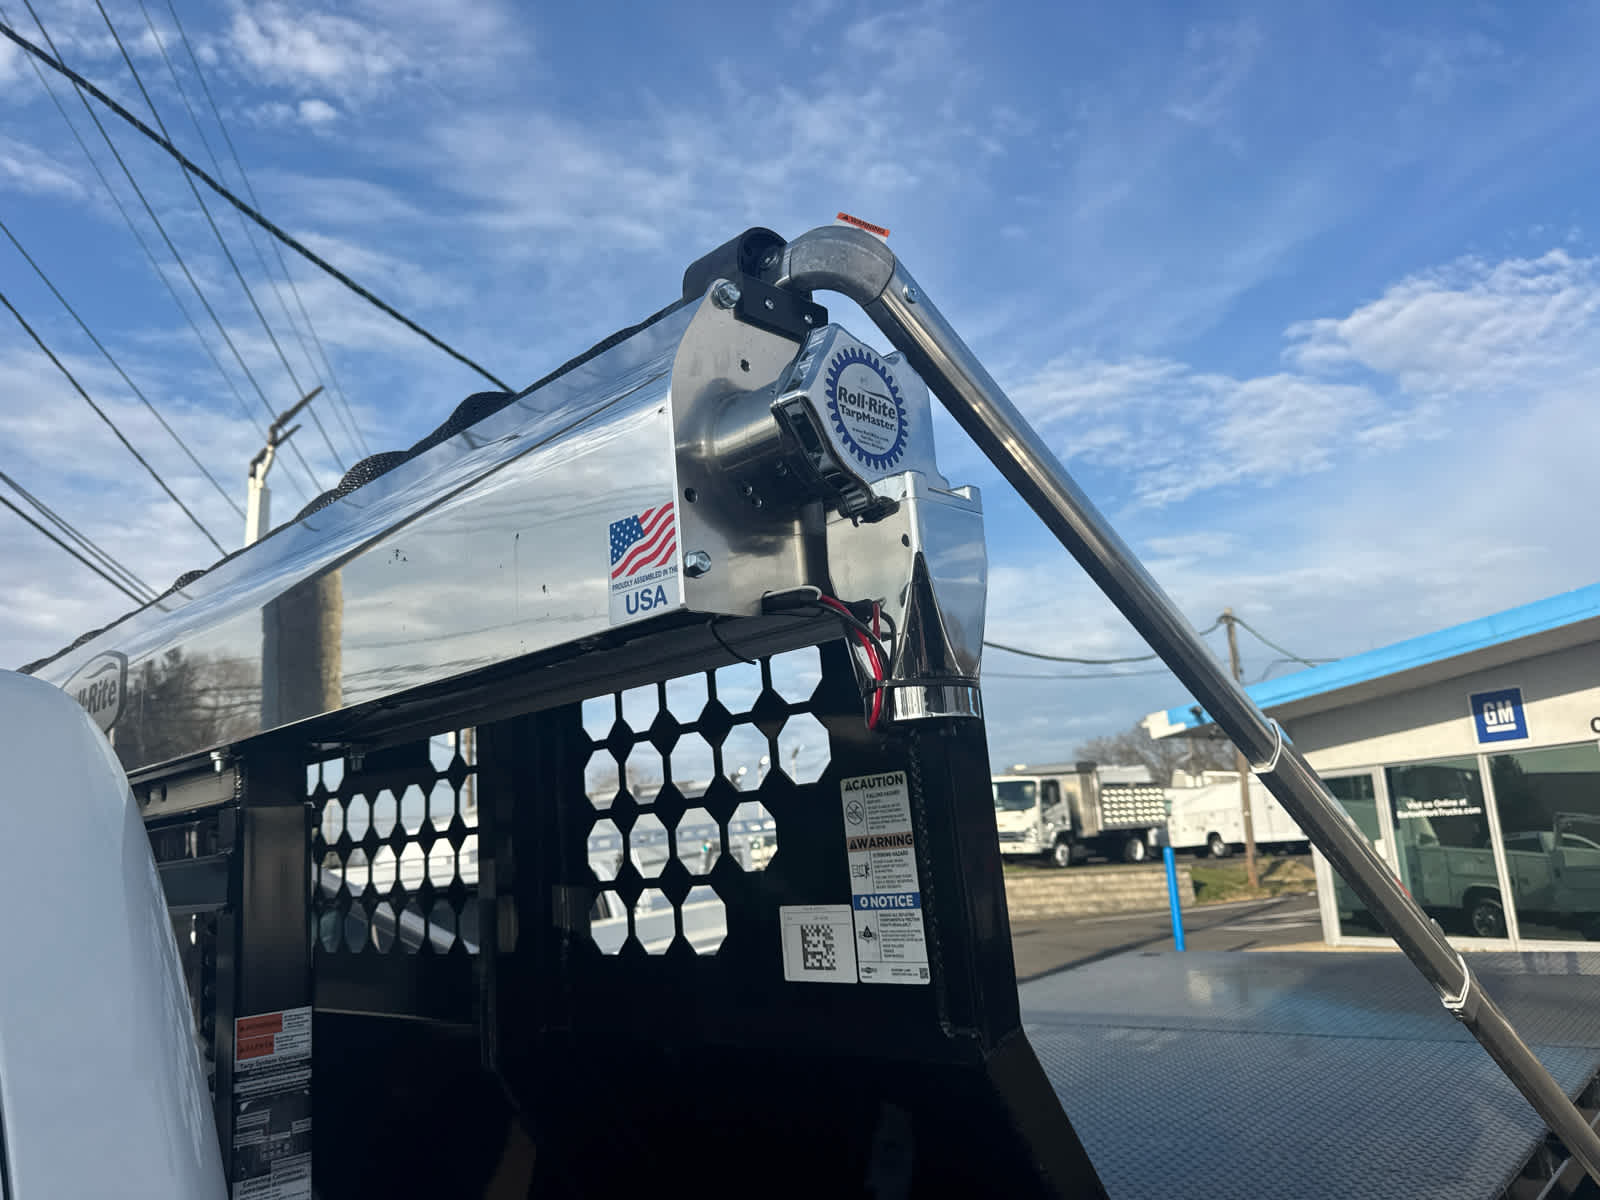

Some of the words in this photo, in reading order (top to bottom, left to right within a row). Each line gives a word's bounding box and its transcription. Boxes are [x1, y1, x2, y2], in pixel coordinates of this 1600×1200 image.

[612, 578, 633, 592] PROUDLY
[633, 570, 663, 585] ASSEMBLED
[625, 584, 668, 615] USA
[1483, 700, 1515, 726] GM
[852, 774, 904, 791] CAUTION
[1406, 800, 1423, 809] Visit
[1433, 799, 1458, 808] Online
[856, 834, 913, 849] WARNING
[870, 894, 914, 908] NOTICE
